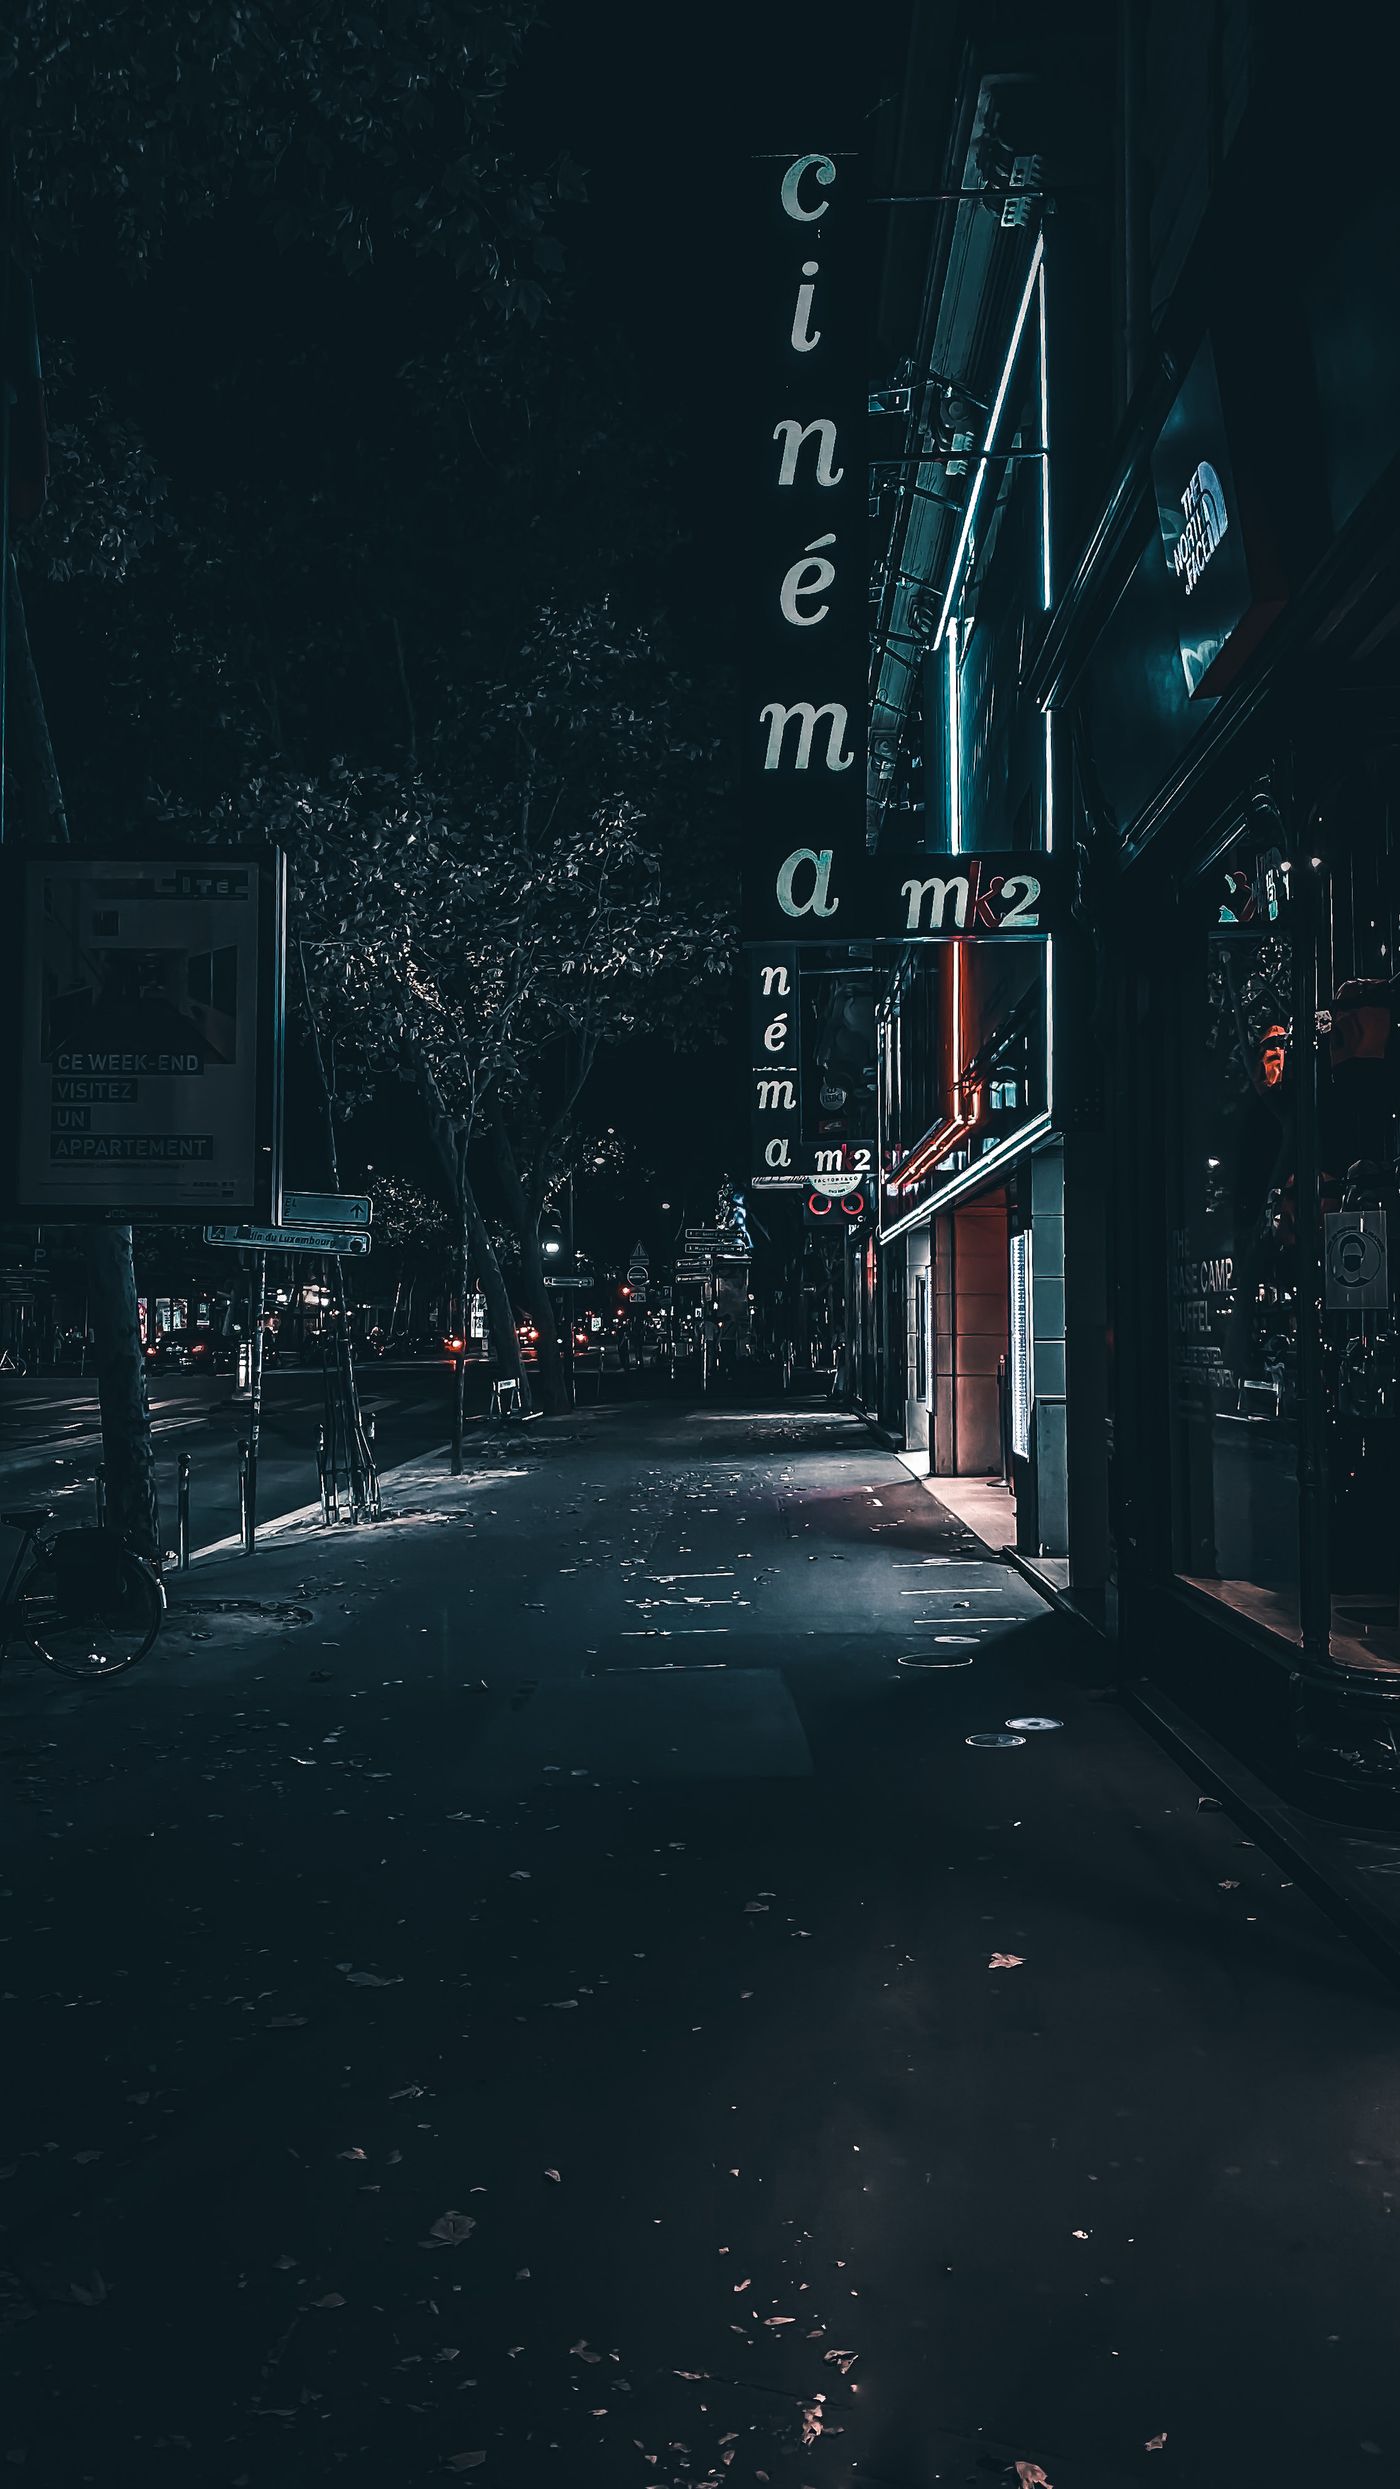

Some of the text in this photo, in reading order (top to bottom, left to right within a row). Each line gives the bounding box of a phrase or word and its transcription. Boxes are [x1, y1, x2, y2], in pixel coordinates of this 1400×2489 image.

[1181, 470, 1200, 520] THE
[760, 154, 855, 918] cinéma
[1174, 503, 1207, 576] NORTH
[1186, 530, 1212, 590] FACE
[901, 860, 1041, 929] mk2
[58, 1054, 200, 1072] CE WEEK-END
[57, 1082, 132, 1099] VISITEZ
[56, 1110, 86, 1128] UN
[55, 1138, 207, 1156] APPARTEMENT
[814, 1143, 872, 1172] mk2
[265, 1232, 277, 1242] du
[278, 1235, 336, 1249] Luxembourg
[1201, 1257, 1234, 1292] CAMP
